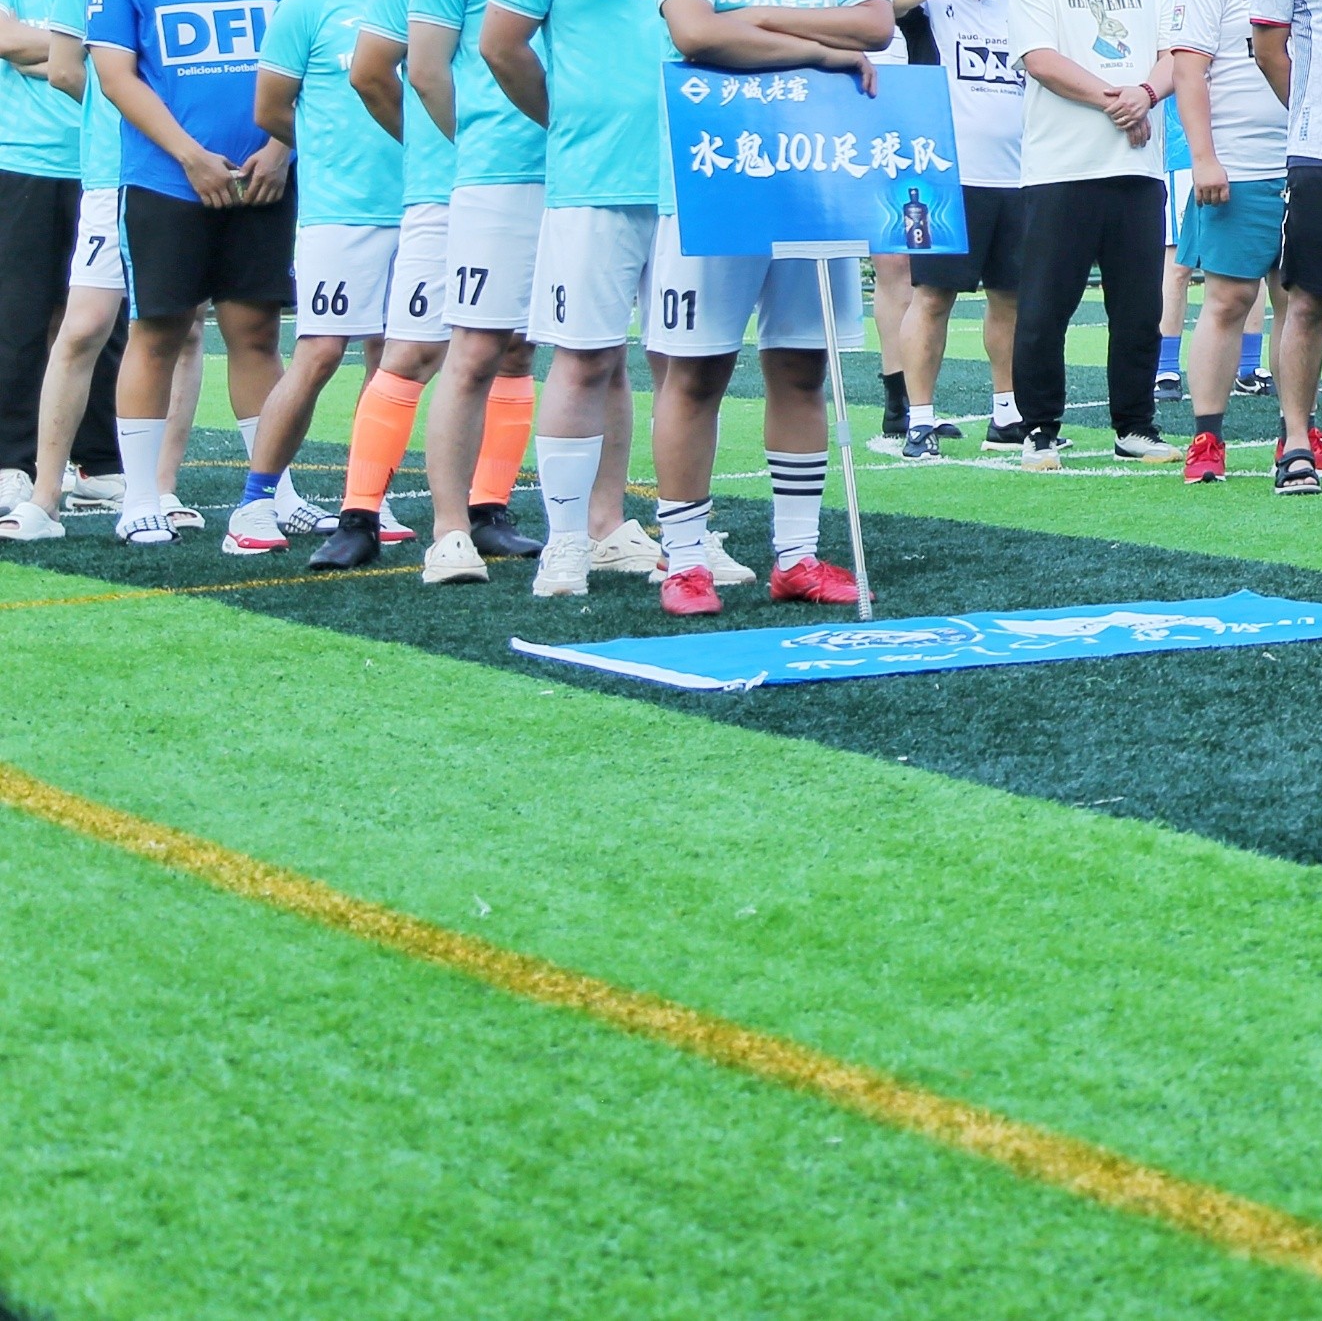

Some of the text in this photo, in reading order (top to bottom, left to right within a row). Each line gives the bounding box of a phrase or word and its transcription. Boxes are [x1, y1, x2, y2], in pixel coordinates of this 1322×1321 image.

[177, 65, 223, 76] Delicious
[720, 74, 809, 106] 沙城老窖
[690, 129, 953, 179] 水鬼101足球队
[86, 235, 106, 267] 7
[311, 281, 349, 316] 66
[409, 281, 428, 318] 6
[456, 266, 489, 306] 17
